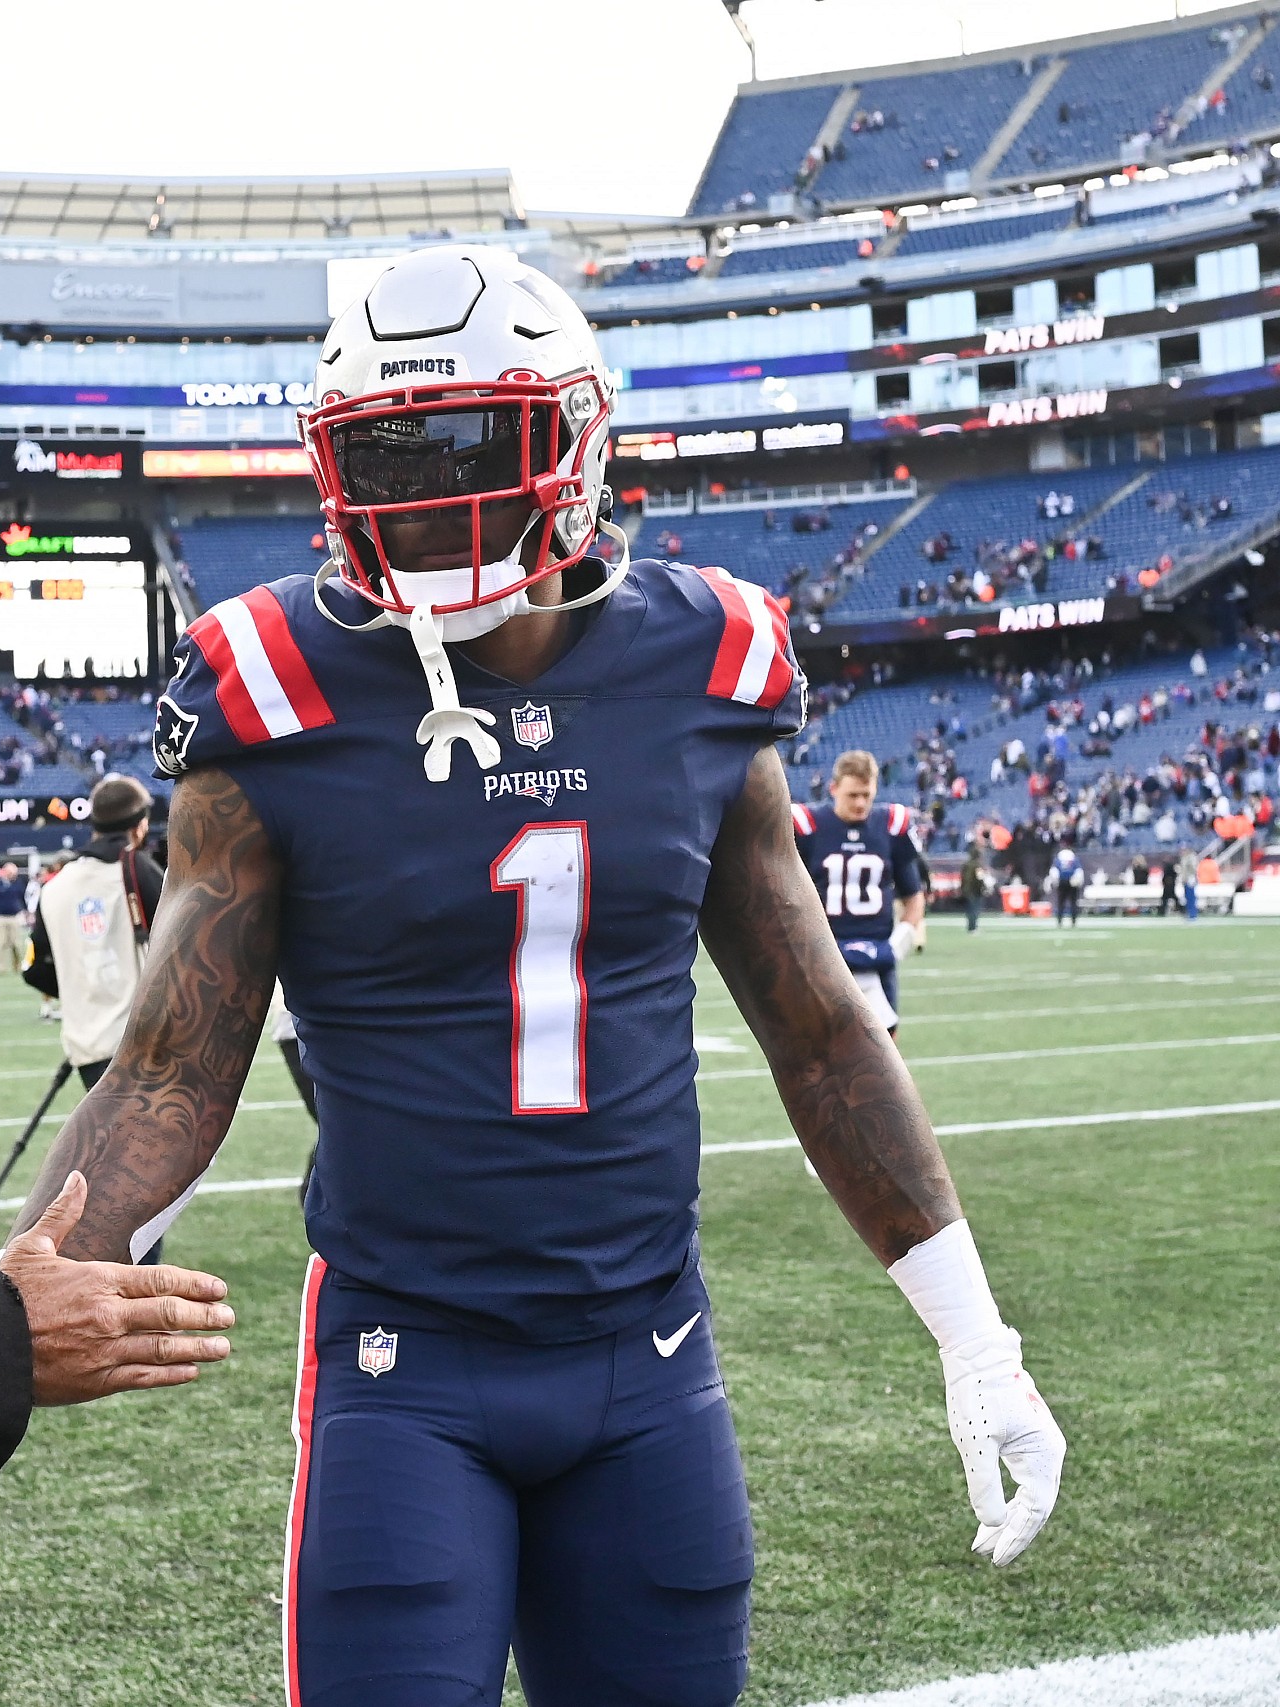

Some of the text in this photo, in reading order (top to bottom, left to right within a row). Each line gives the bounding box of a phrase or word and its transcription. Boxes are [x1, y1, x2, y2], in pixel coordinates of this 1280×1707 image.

[984, 312, 1105, 354] PATS WIN
[380, 358, 456, 380] PATRIOTS
[181, 382, 283, 406] TODAY'S
[987, 389, 1108, 427] PATS WIN
[998, 597, 1105, 632] PATS WIN
[519, 722, 547, 741] NFL
[483, 768, 588, 802] PATRIOTS
[822, 853, 885, 917] 10
[489, 820, 590, 1115] 1
[364, 1349, 389, 1368] NFL
